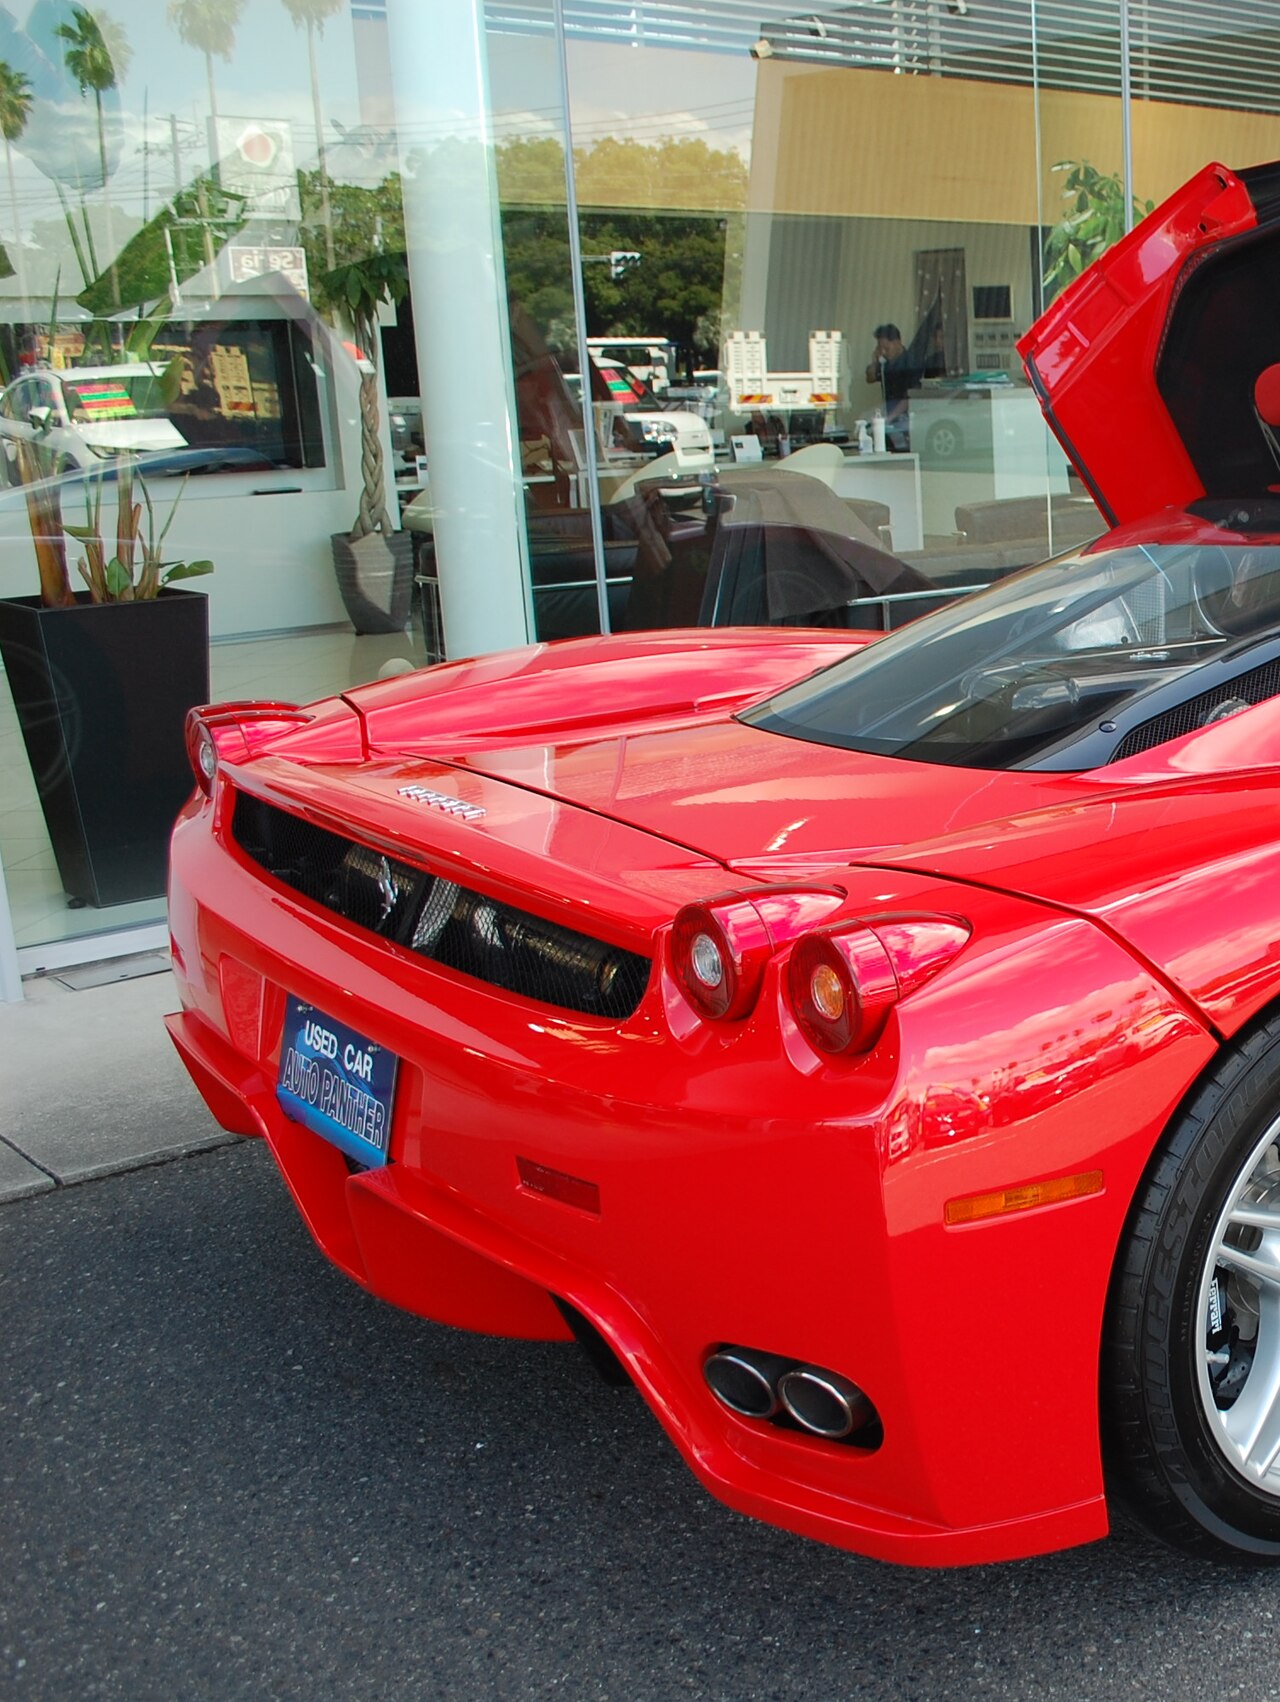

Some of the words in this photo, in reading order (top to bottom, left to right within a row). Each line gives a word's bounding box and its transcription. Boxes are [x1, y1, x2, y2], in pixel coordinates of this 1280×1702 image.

[304, 1020, 338, 1059] USED
[344, 1044, 373, 1082] CAR
[282, 1047, 320, 1105] AUTO
[320, 1069, 386, 1149] PANTHER
[1146, 1060, 1270, 1480] BRIDGESTONE
[1208, 1277, 1223, 1334] Ferrari
